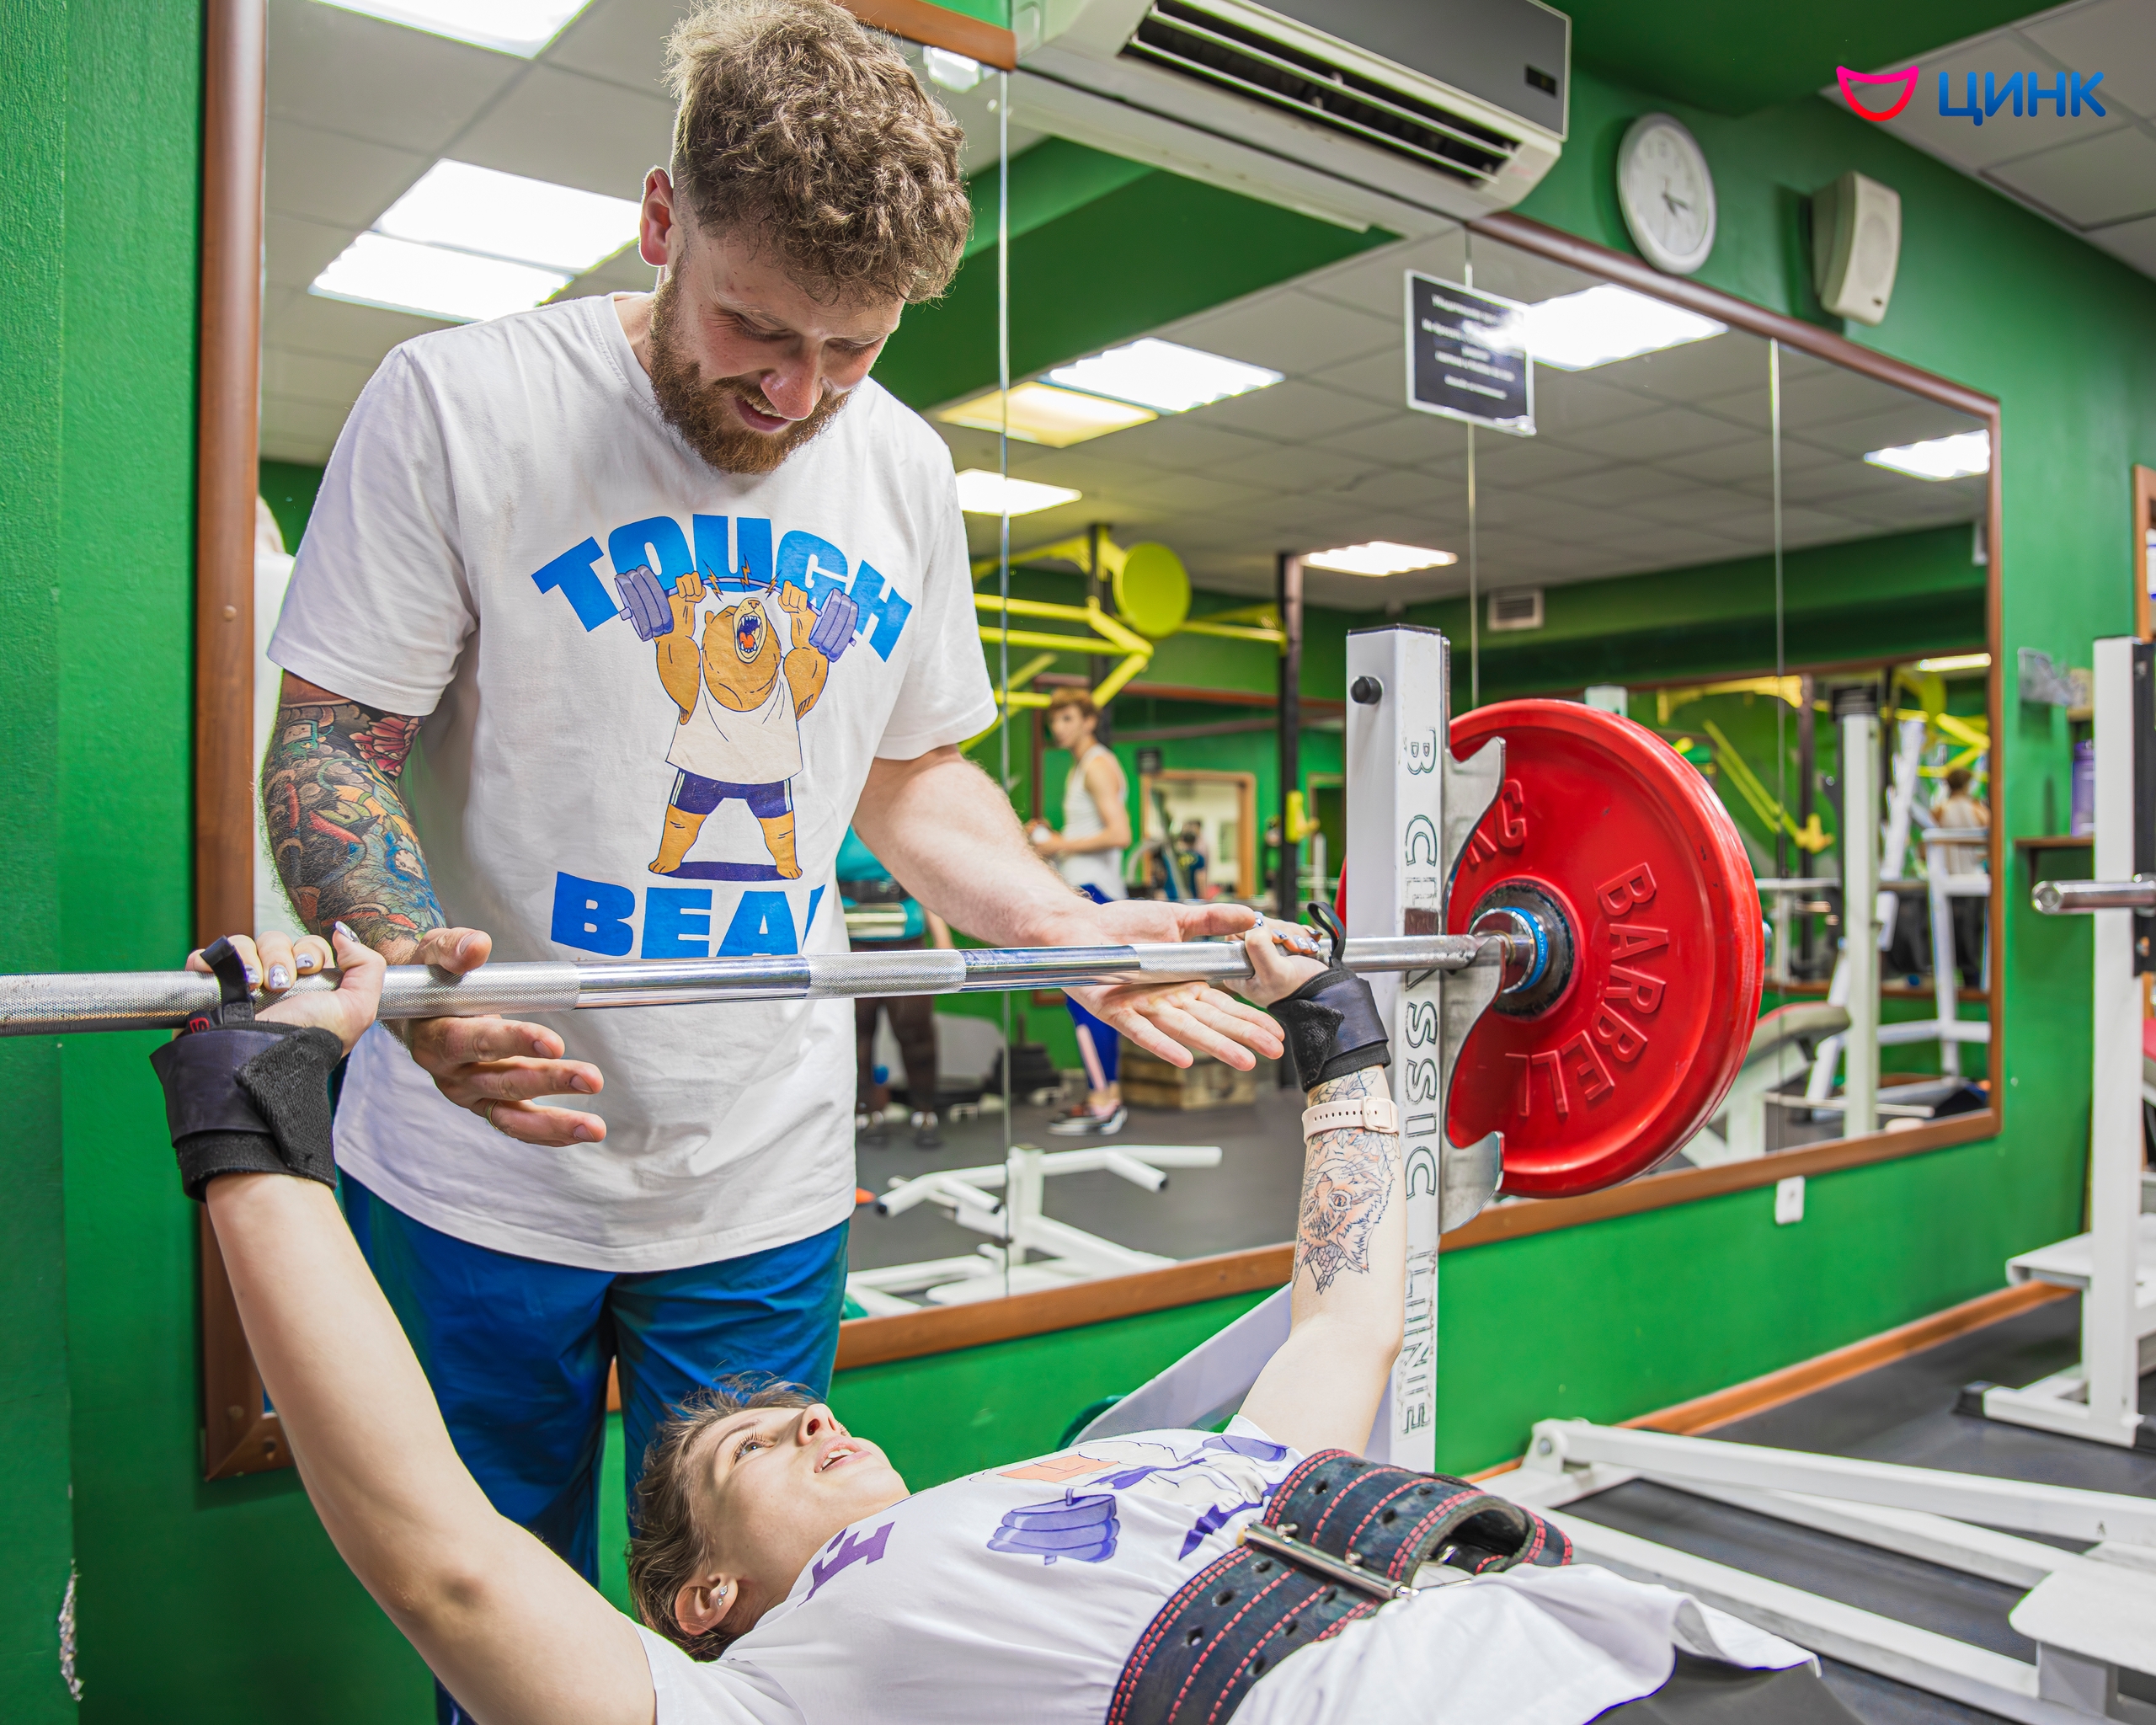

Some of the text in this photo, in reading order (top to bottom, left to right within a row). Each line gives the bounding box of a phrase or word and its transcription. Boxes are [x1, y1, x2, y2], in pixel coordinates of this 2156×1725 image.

[531, 514, 912, 662] TOUGH
[551, 871, 825, 959] BEA
[1405, 814, 1438, 1200] CLSSIC
[1505, 862, 1669, 1118] BARBELL
